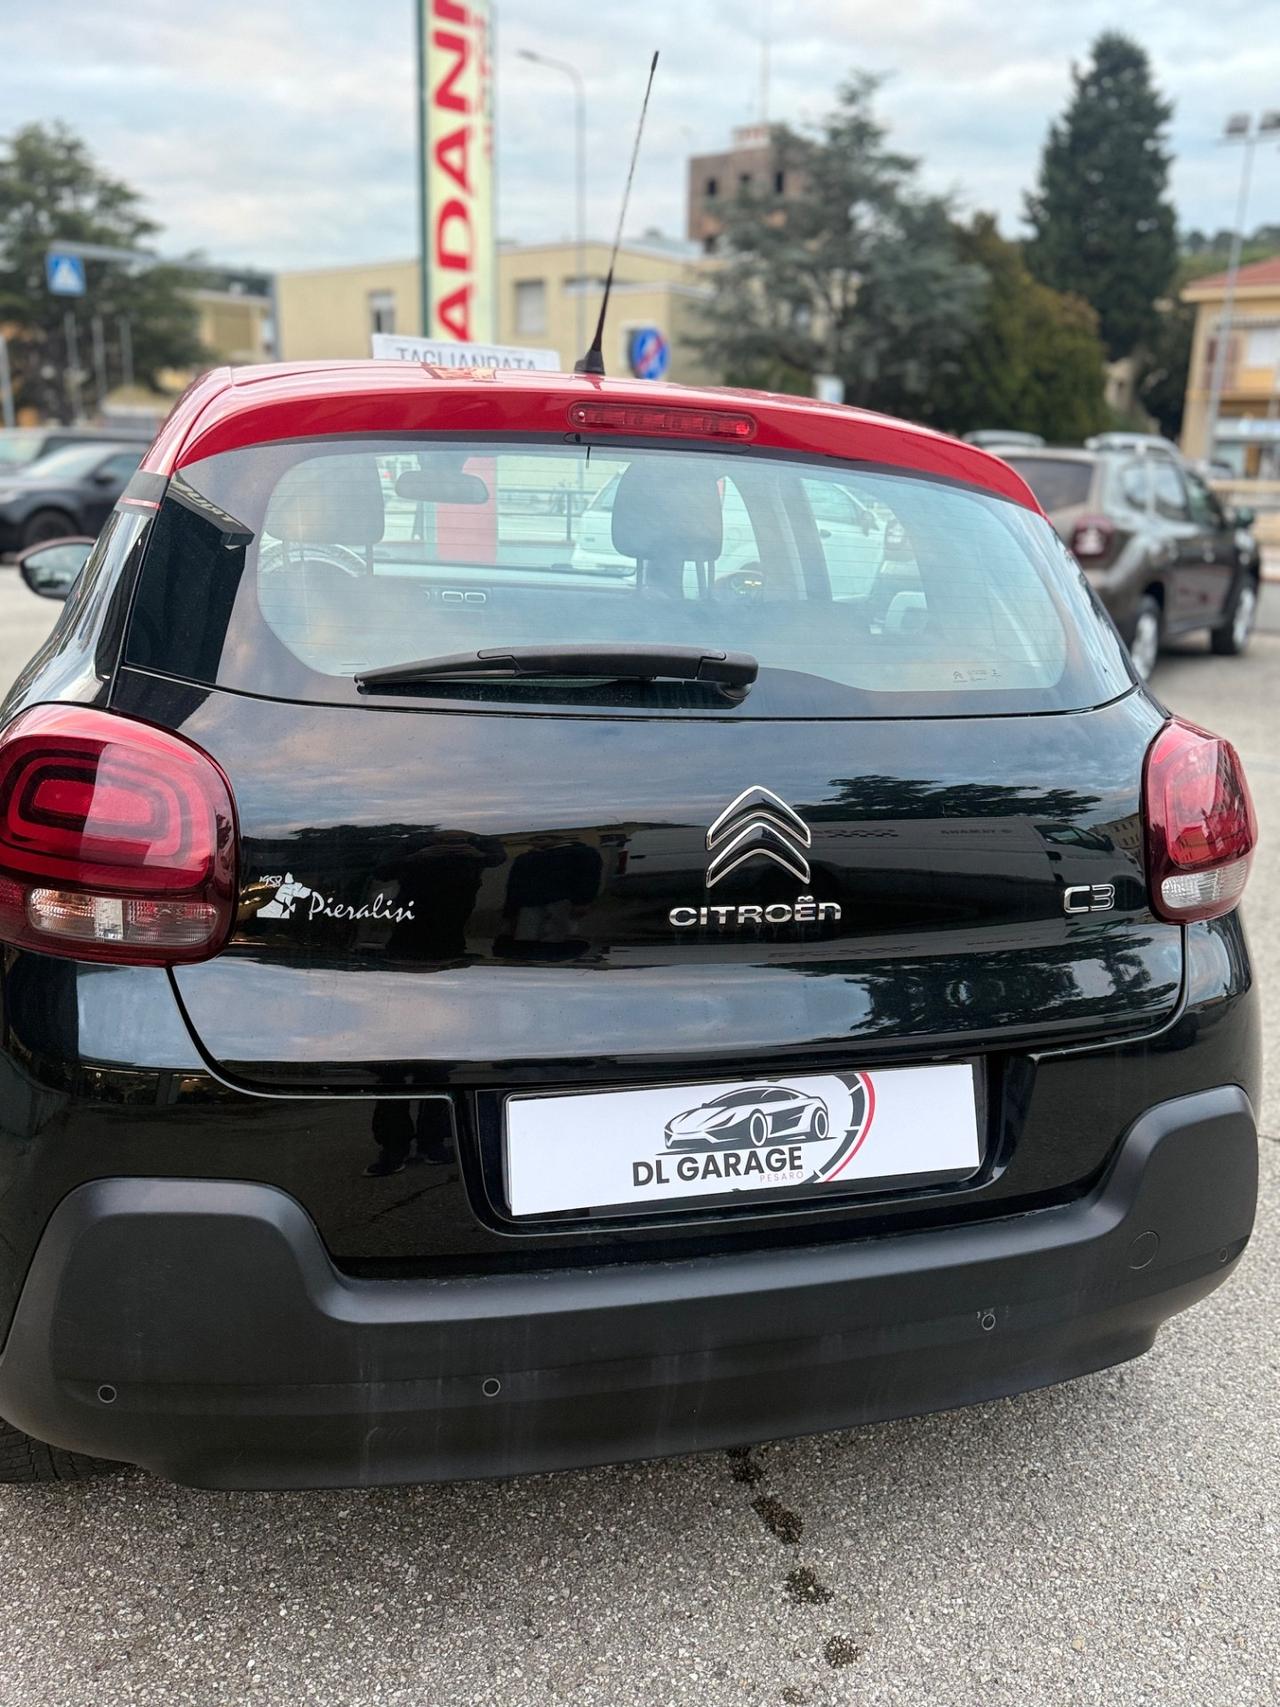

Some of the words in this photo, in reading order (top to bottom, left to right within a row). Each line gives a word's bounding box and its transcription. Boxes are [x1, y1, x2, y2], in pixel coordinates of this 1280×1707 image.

[308, 891, 415, 922] Pieralisi
[1063, 884, 1116, 914] C3
[632, 1160, 670, 1187] DL
[677, 1146, 803, 1180] GARAGE
[759, 1170, 804, 1183] PESARO
